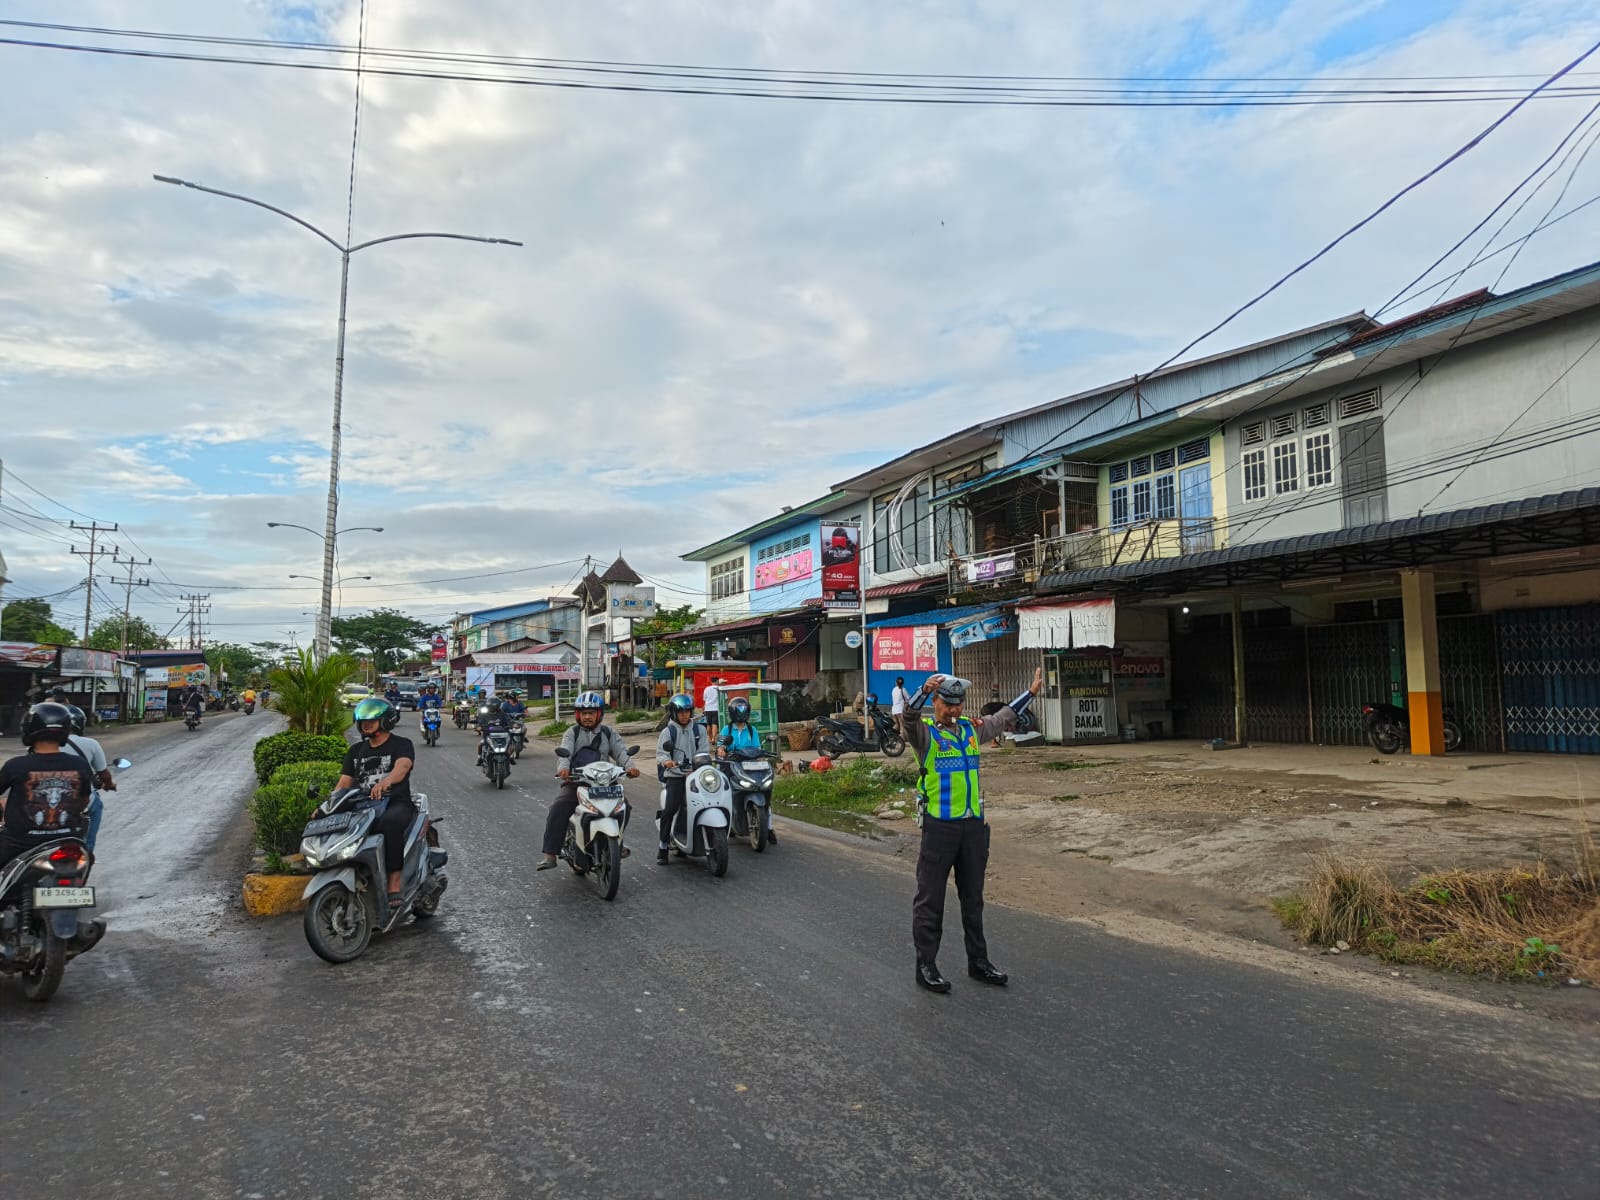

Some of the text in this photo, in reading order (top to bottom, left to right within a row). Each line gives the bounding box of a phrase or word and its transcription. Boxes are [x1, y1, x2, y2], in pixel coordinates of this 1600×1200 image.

[1069, 687, 1109, 696] BANDUNG
[1079, 700, 1098, 713] ROTI
[1074, 715, 1104, 729] BAKAR
[40, 889, 52, 897] KB
